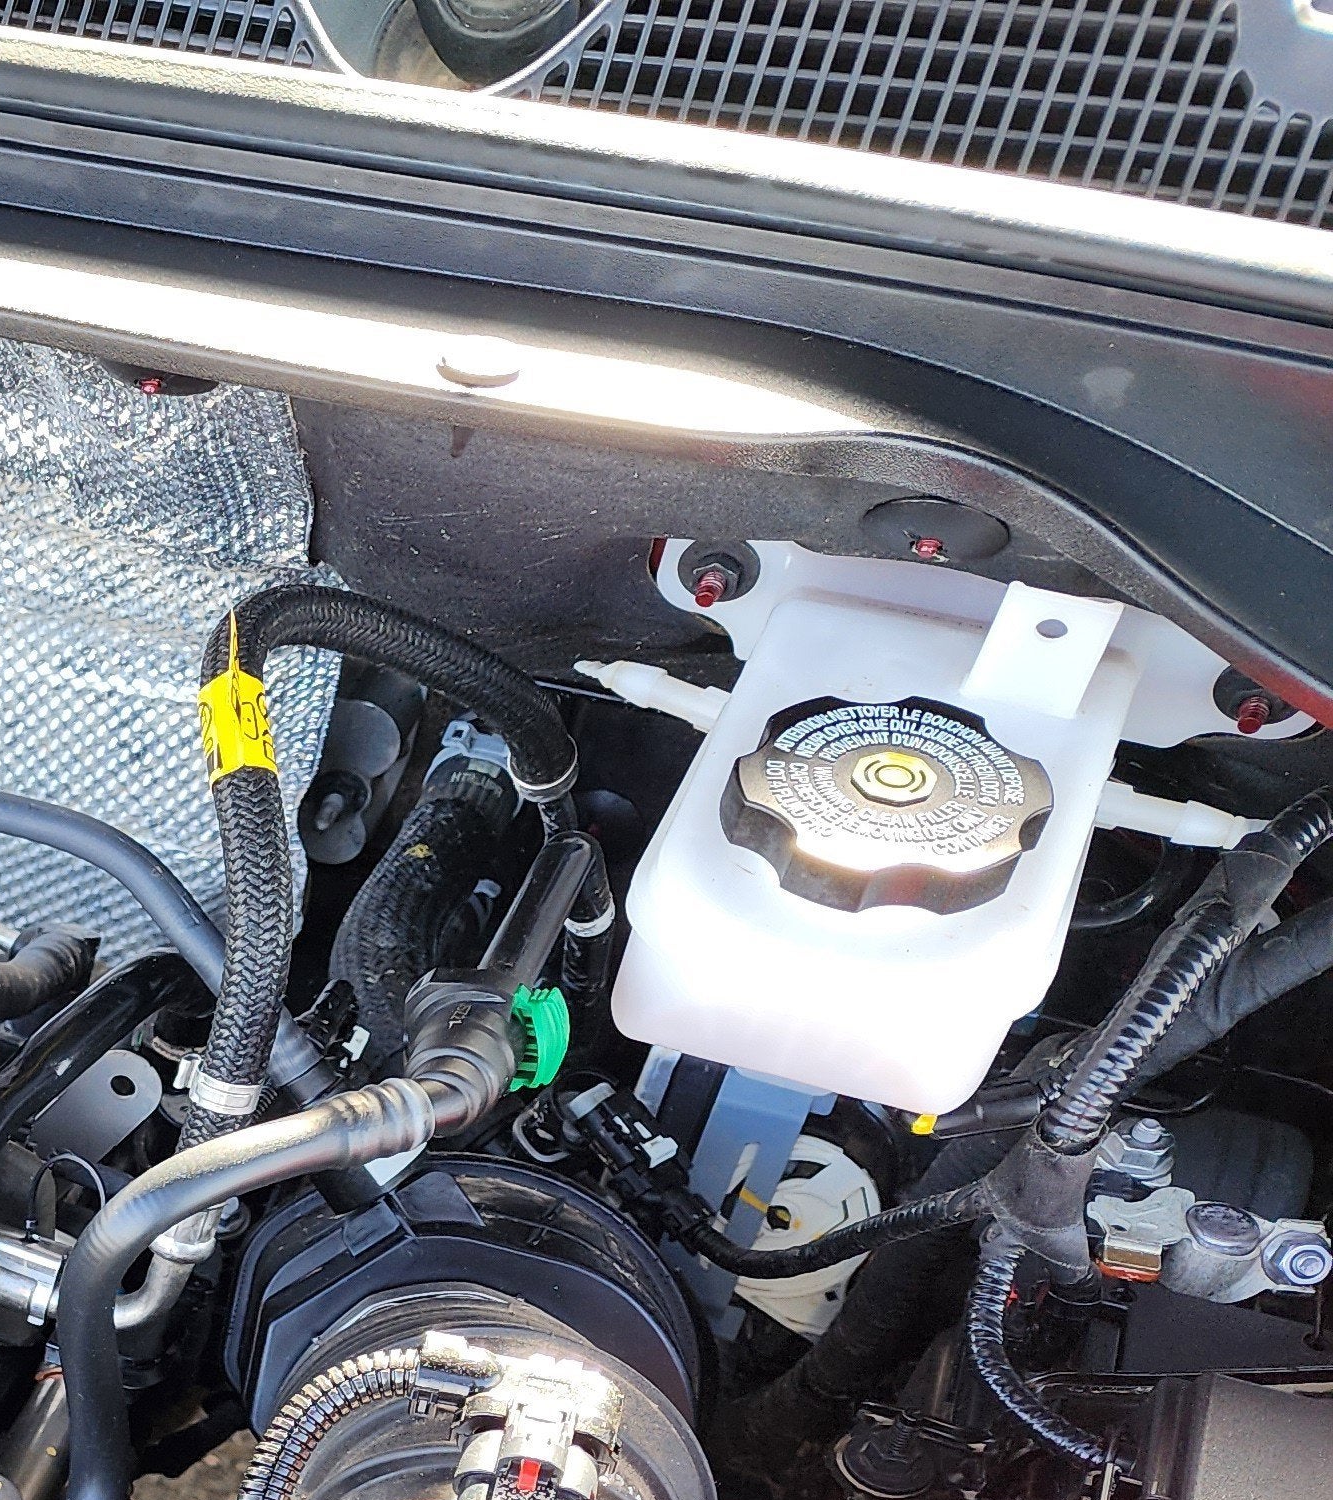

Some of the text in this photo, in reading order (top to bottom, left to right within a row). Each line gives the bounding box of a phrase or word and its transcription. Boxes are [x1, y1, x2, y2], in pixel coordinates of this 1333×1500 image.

[817, 731, 890, 761] PROVENANT
[824, 704, 899, 722] NETTOYER
[902, 706, 922, 721] LE
[920, 709, 987, 744] BOUCHON
[973, 739, 1015, 767] AVANT
[855, 718, 889, 731] QUE
[888, 717, 911, 733] DU
[909, 721, 965, 748] LIQUIDE
[952, 742, 980, 757] DE
[913, 798, 968, 827] FILLER
